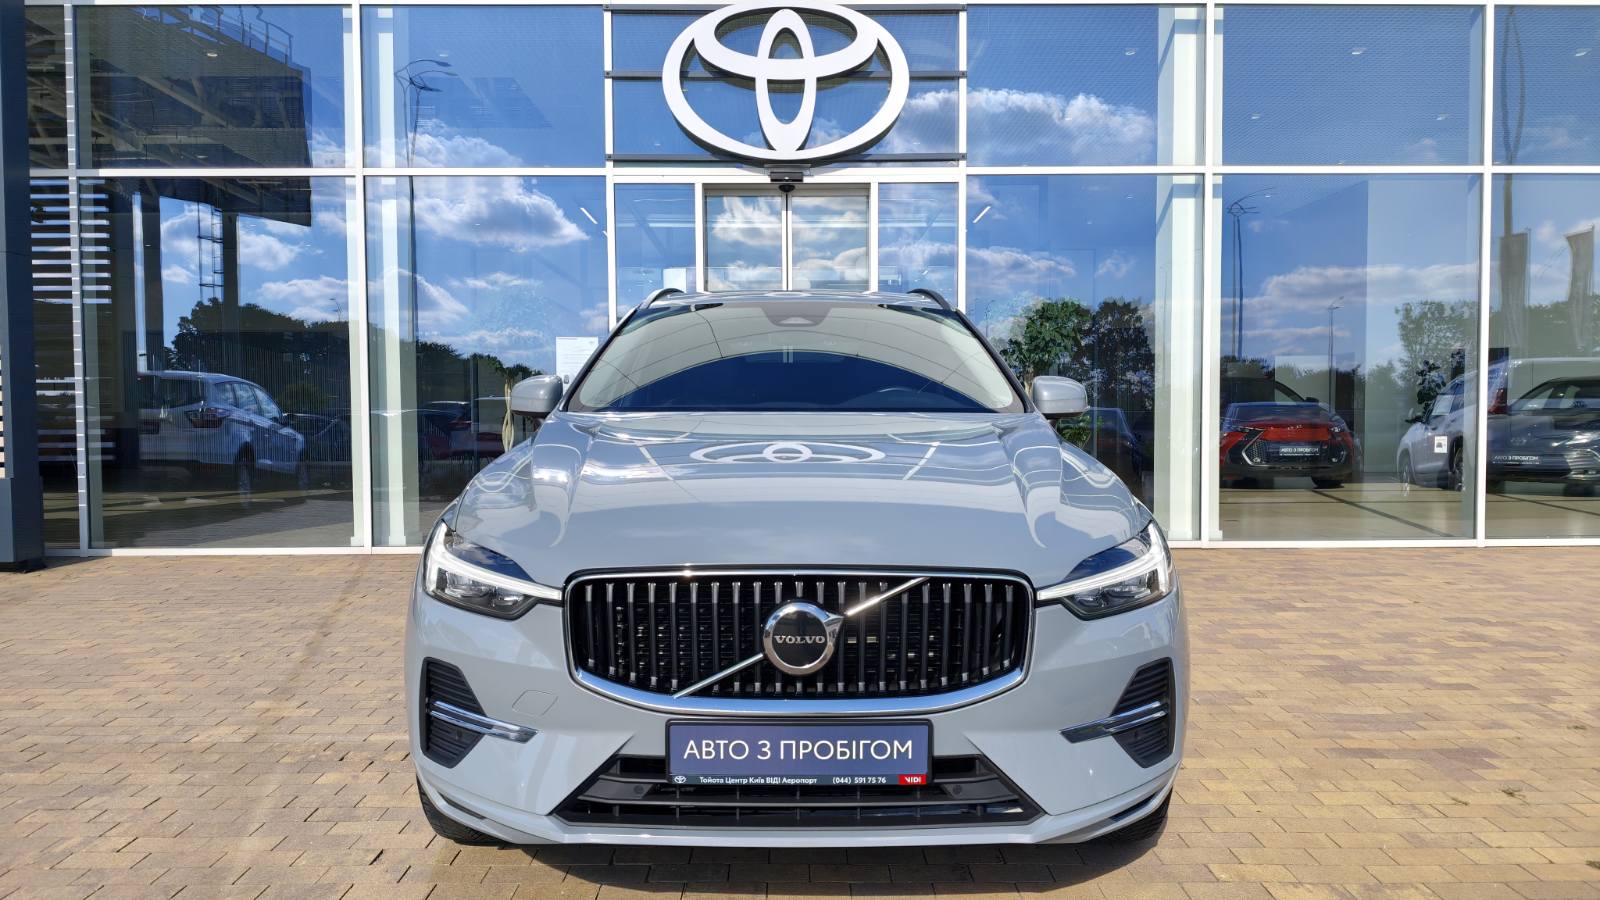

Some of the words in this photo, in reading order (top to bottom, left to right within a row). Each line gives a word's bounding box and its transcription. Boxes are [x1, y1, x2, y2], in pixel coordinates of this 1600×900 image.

[774, 635, 826, 644] VOLVO
[683, 739, 750, 760] АВТО
[757, 739, 772, 760] З
[779, 739, 913, 760] ПРОБІГОМ
[699, 776, 724, 784] Тойота
[725, 777, 748, 785] Центр
[749, 776, 765, 784] Київ
[766, 777, 780, 785] ВІДІ
[782, 777, 818, 785] Аеропорт
[832, 777, 852, 785] (044)
